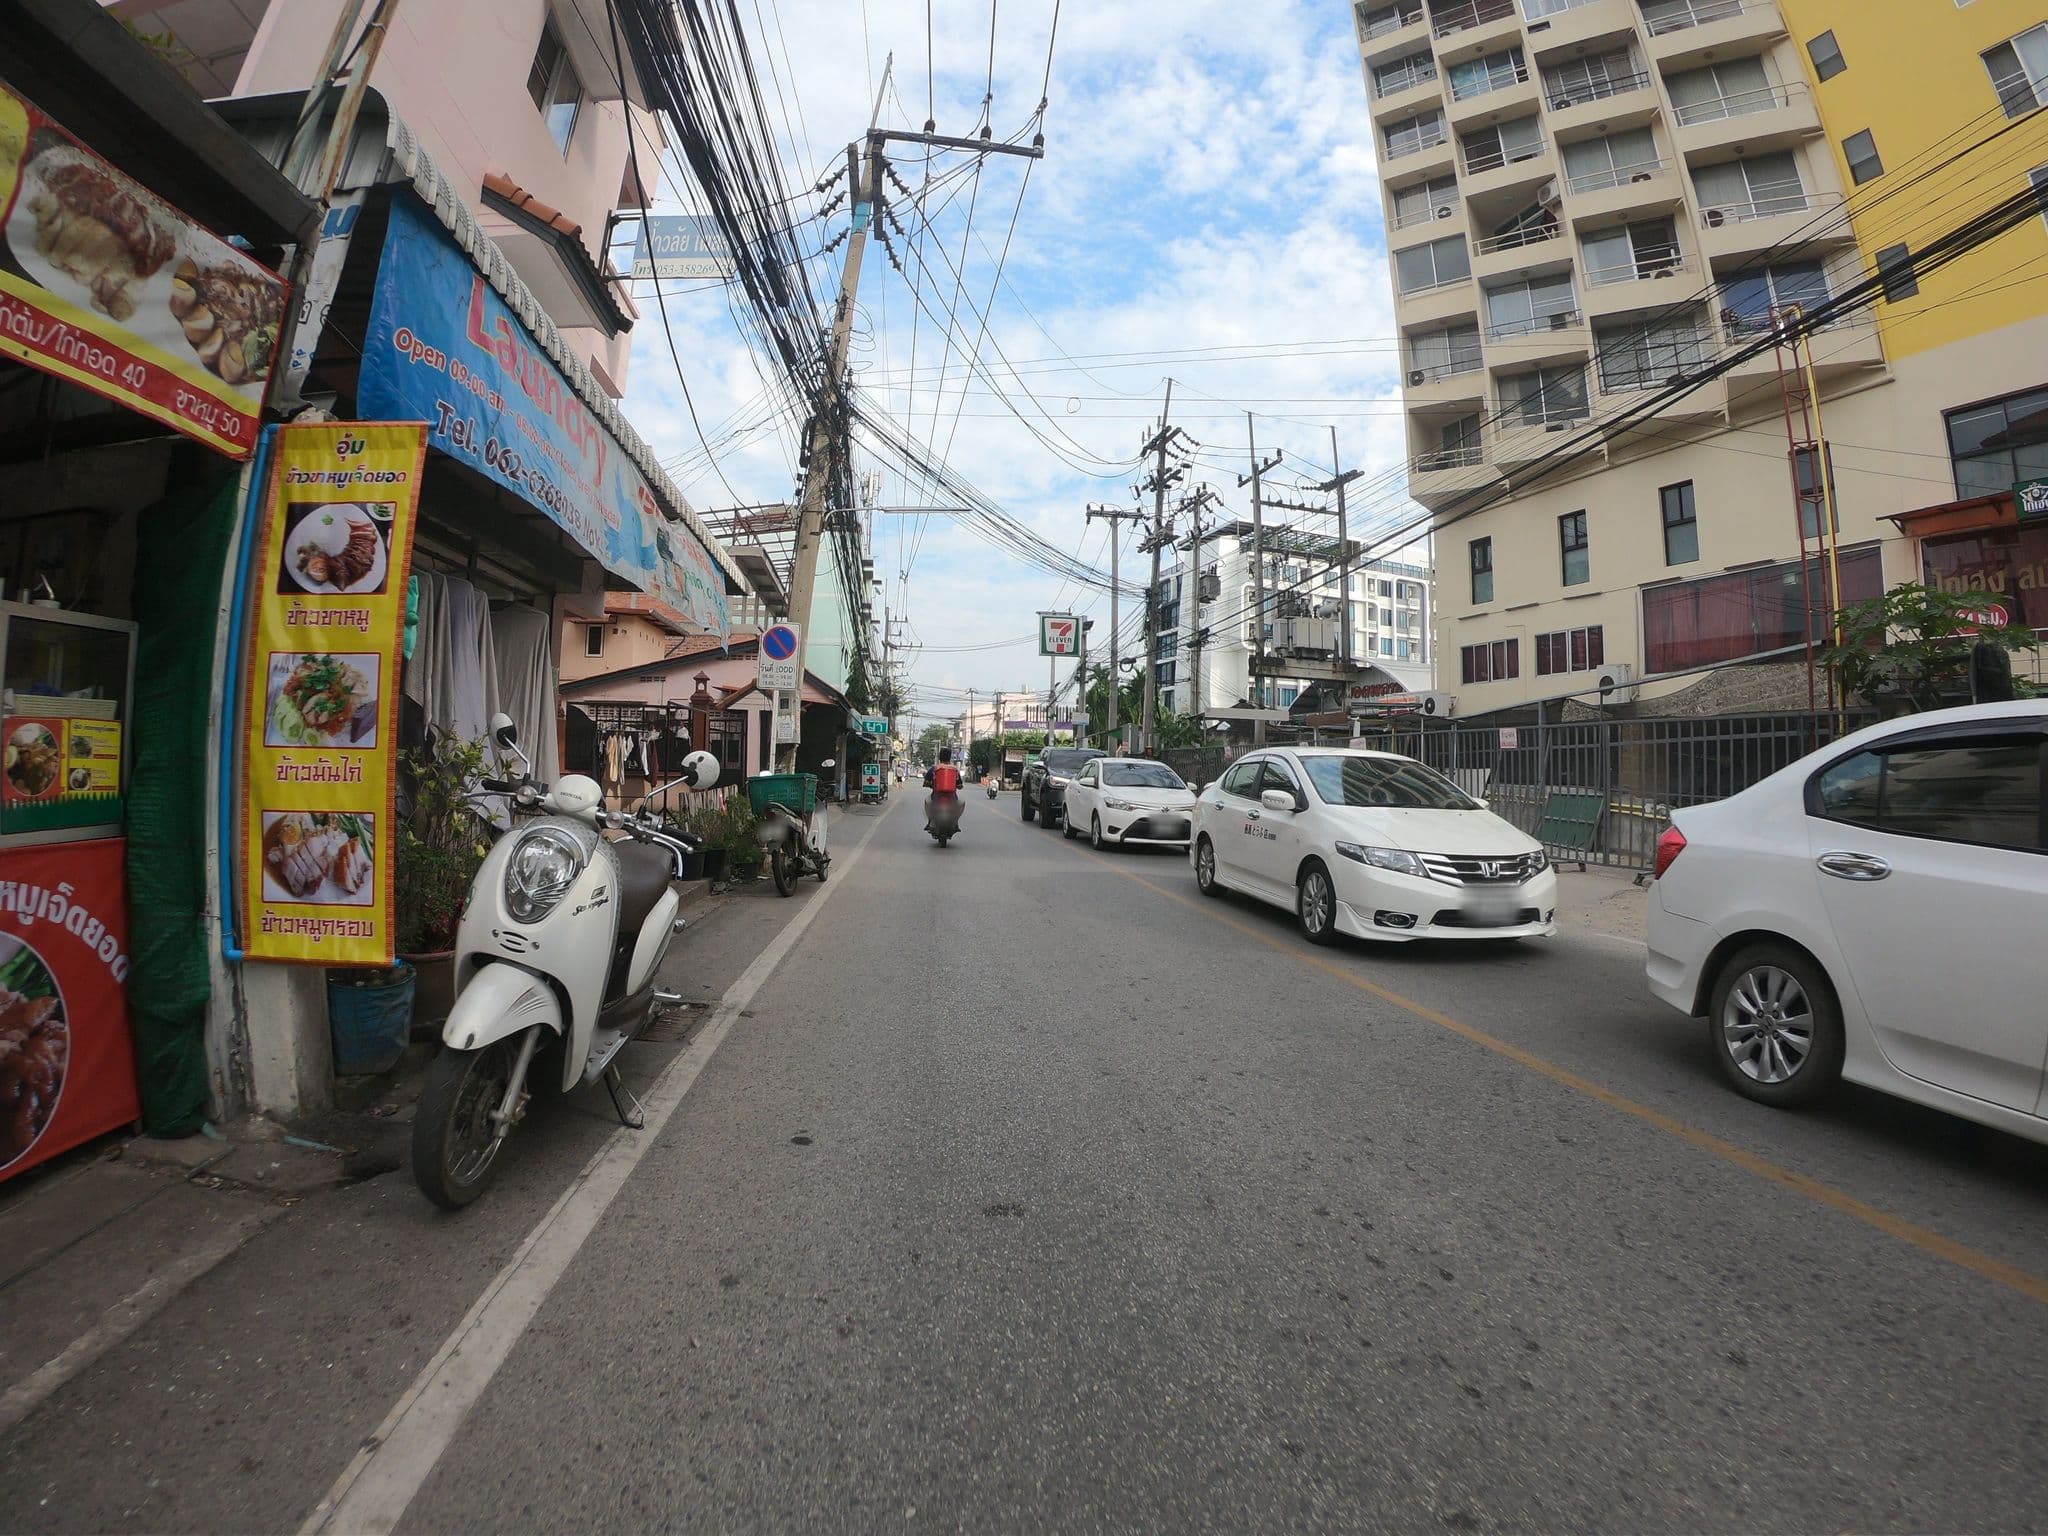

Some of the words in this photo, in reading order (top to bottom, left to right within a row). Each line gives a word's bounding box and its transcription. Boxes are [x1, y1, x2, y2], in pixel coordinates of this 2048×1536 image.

[0, 294, 117, 378] ก่ต้ม/ไก่ทอด
[121, 365, 147, 389] 40
[394, 327, 446, 373] Open
[467, 274, 607, 490] Laundry
[176, 388, 217, 433] ขาหมู
[221, 411, 241, 437] 50
[437, 400, 477, 455] Tel.
[336, 432, 365, 462] อุ้ม
[286, 464, 407, 489] ข้าวขาหมูเจ็ดยอด
[287, 601, 370, 632] ข้าวขาหมู
[276, 756, 362, 782] ข้าวมันไก่
[262, 909, 374, 942] ข้าวหมูกรอบ
